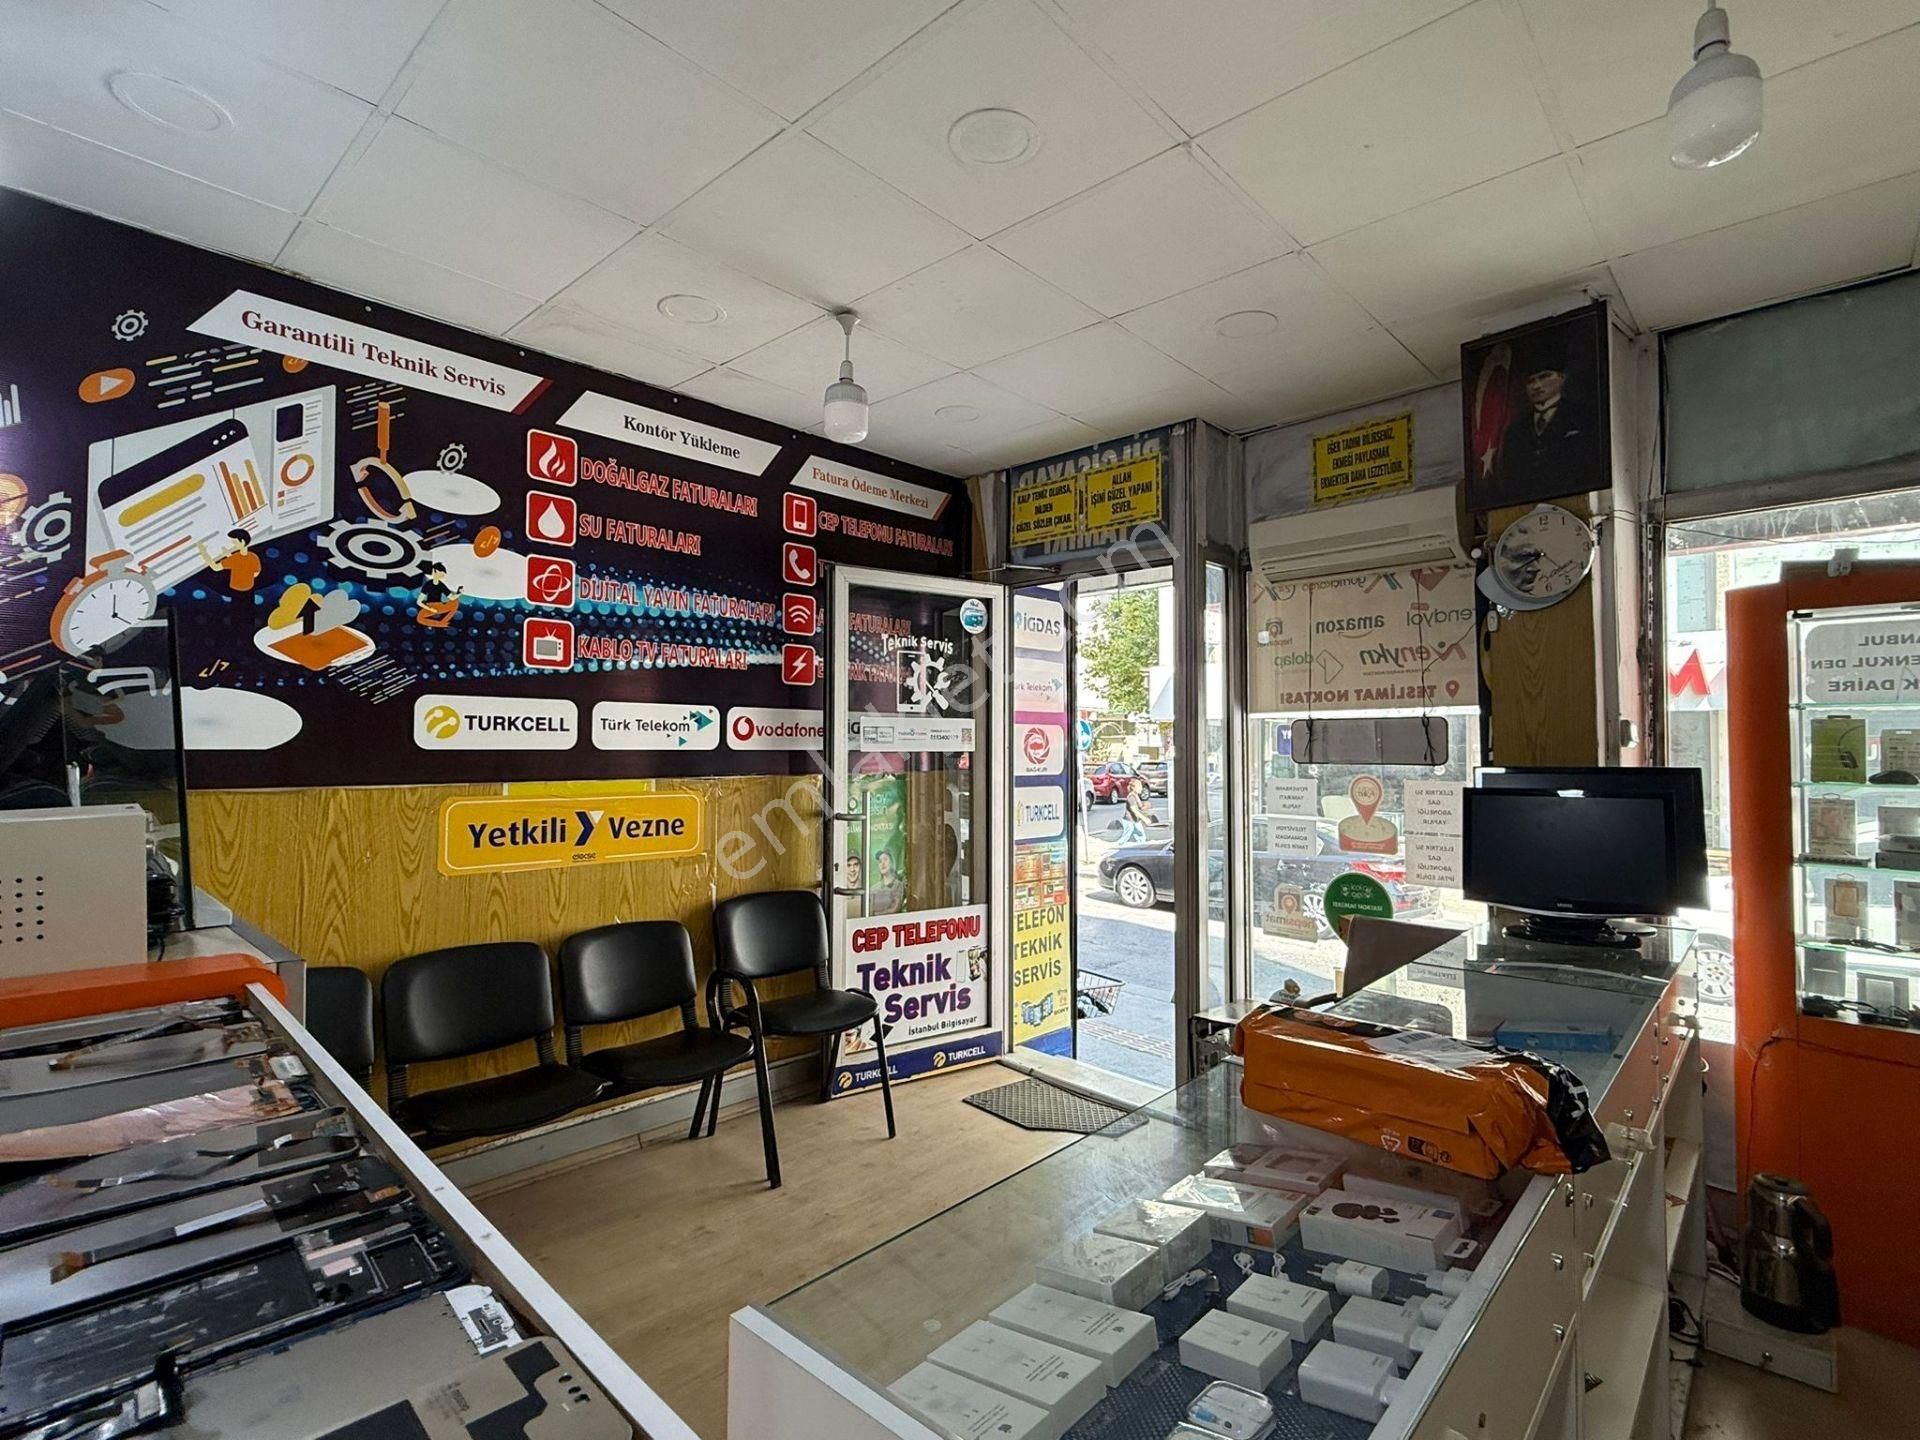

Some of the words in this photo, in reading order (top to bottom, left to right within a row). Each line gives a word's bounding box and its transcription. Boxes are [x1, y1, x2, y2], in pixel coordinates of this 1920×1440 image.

[241, 310, 355, 355] Garantili
[362, 342, 439, 379] Teknik
[443, 365, 507, 396] Servis
[623, 415, 677, 442] Kontör
[679, 430, 741, 459] Yükleme
[580, 457, 670, 498] DOĞALGAZ
[671, 479, 758, 518] FATURALARI
[812, 467, 849, 488] Fatura
[851, 475, 888, 498] Ödeme
[890, 488, 929, 509] Merkezi
[1107, 486, 1127, 500] GÜZEL
[1112, 471, 1132, 484] ALLAH
[579, 513, 601, 538] SU
[606, 519, 702, 556] FATURALARI
[818, 510, 839, 532] CEP
[841, 516, 894, 545] TELEFONU
[895, 527, 954, 557] FATURALARI
[579, 573, 639, 607] DİJİTAL
[643, 586, 690, 611] YAYIN
[692, 590, 776, 623] FATURALARI
[577, 634, 632, 661] KABLO
[635, 640, 657, 662] TV
[660, 641, 748, 671] FATURALARI
[881, 633, 918, 656] Teknik
[920, 635, 955, 655] Servis
[464, 714, 570, 733] TURKCELL
[600, 717, 631, 731] Türk
[635, 718, 690, 733] Telekom
[1025, 803, 1060, 822] TURKCELL
[468, 817, 567, 849] Yetkili
[608, 817, 685, 840] Vezne
[852, 926, 889, 953] CEP
[892, 914, 981, 948] TELEFONU
[857, 952, 952, 993] Teknik
[1014, 958, 1062, 988] SERVİS
[884, 983, 972, 1024] Servis
[908, 1020, 940, 1036] İstanbul
[941, 1015, 978, 1033] Bilgisayar
[948, 1045, 986, 1062] TURKCELL
